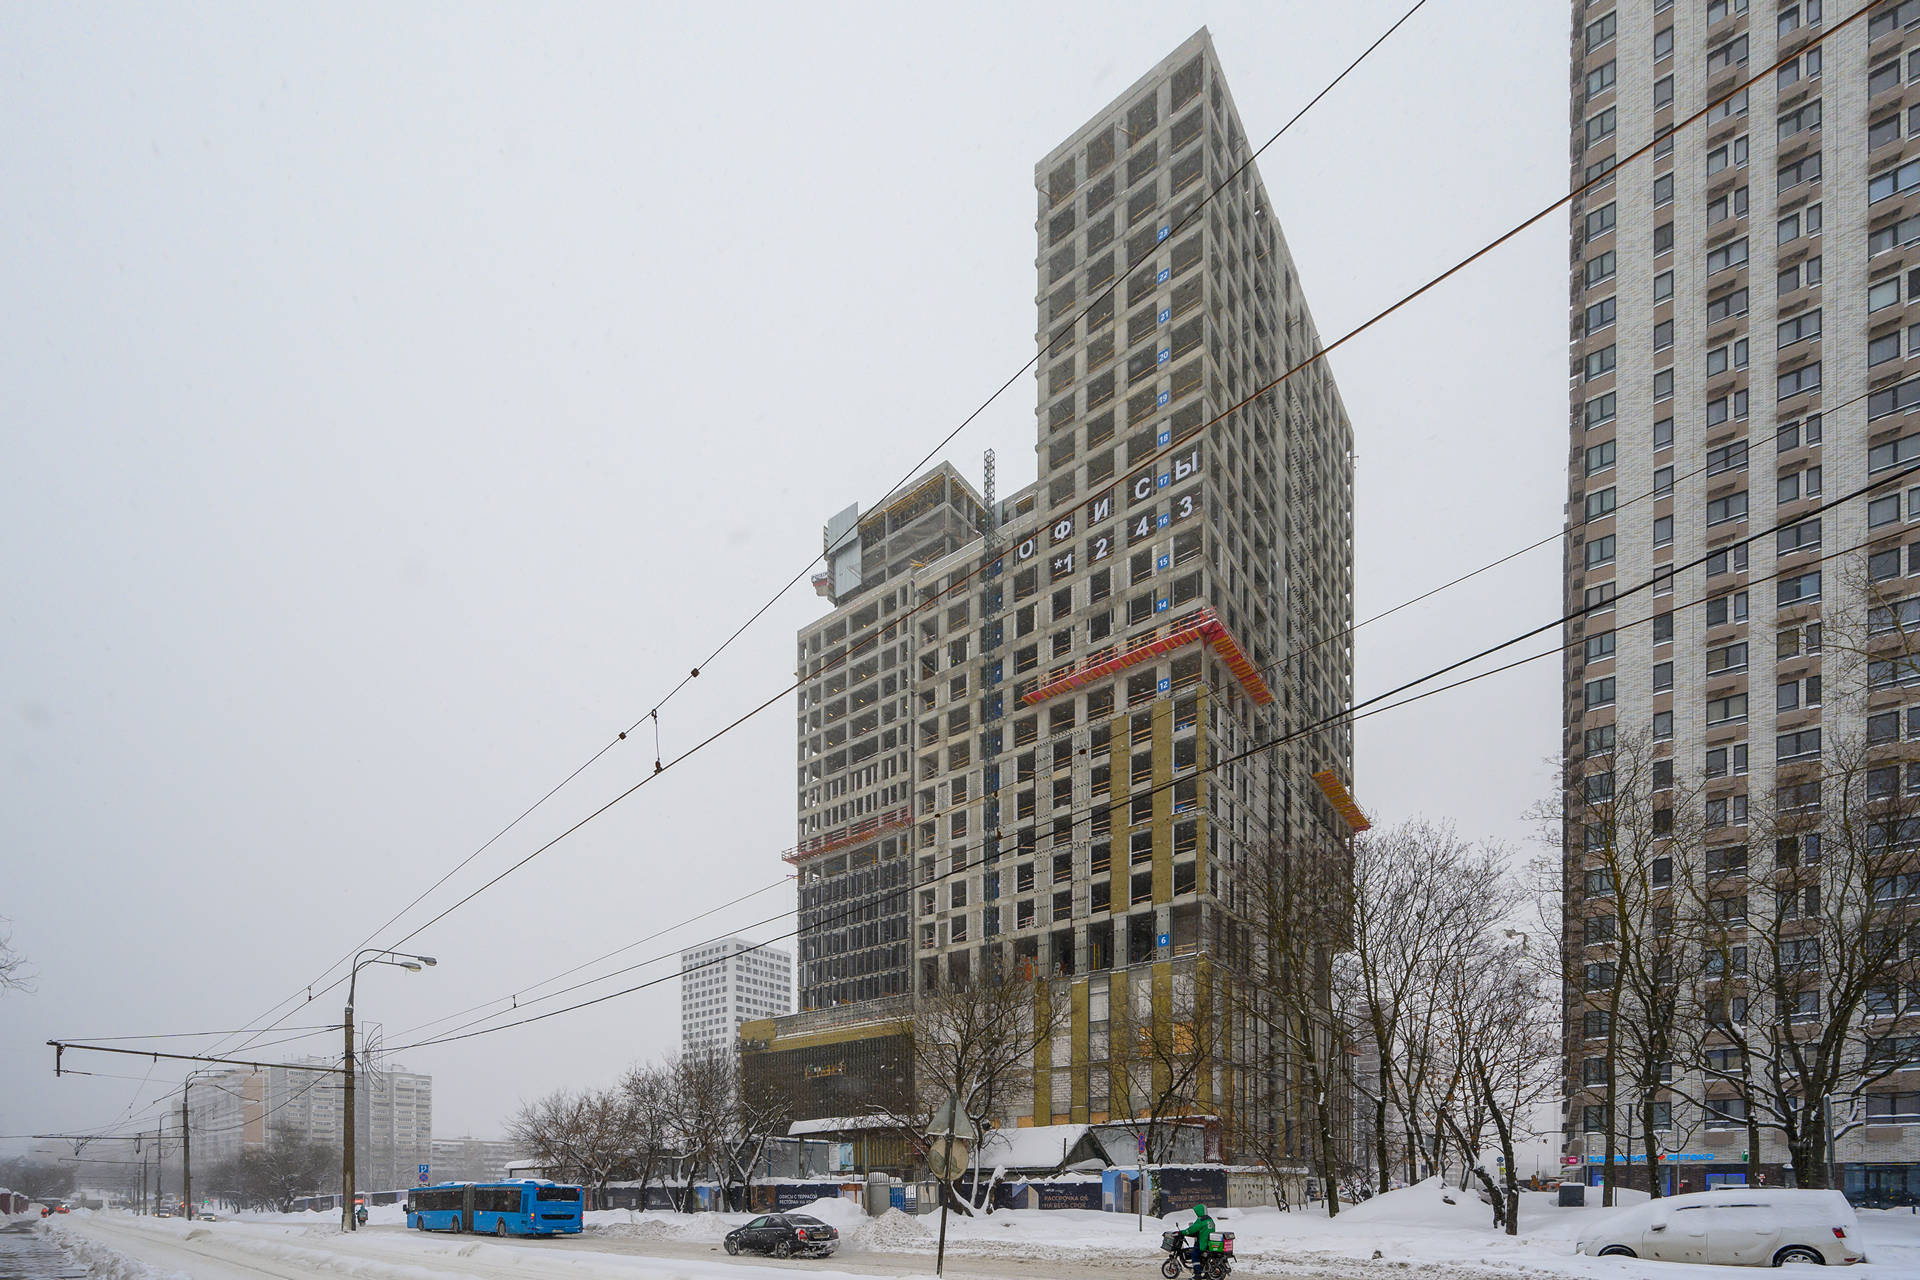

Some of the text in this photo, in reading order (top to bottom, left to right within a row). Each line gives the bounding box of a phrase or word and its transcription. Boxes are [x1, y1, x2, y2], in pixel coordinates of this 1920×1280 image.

[1158, 270, 1169, 281] 22
[1159, 350, 1169, 361] 20
[1158, 393, 1168, 404] 19
[1159, 433, 1169, 444] 18
[1159, 475, 1168, 487] 17
[1018, 451, 1198, 560] ОФИСЫ
[1158, 515, 1168, 527] 16
[1159, 556, 1168, 568] 15
[1158, 600, 1167, 611] 14
[1159, 680, 1168, 690] 12
